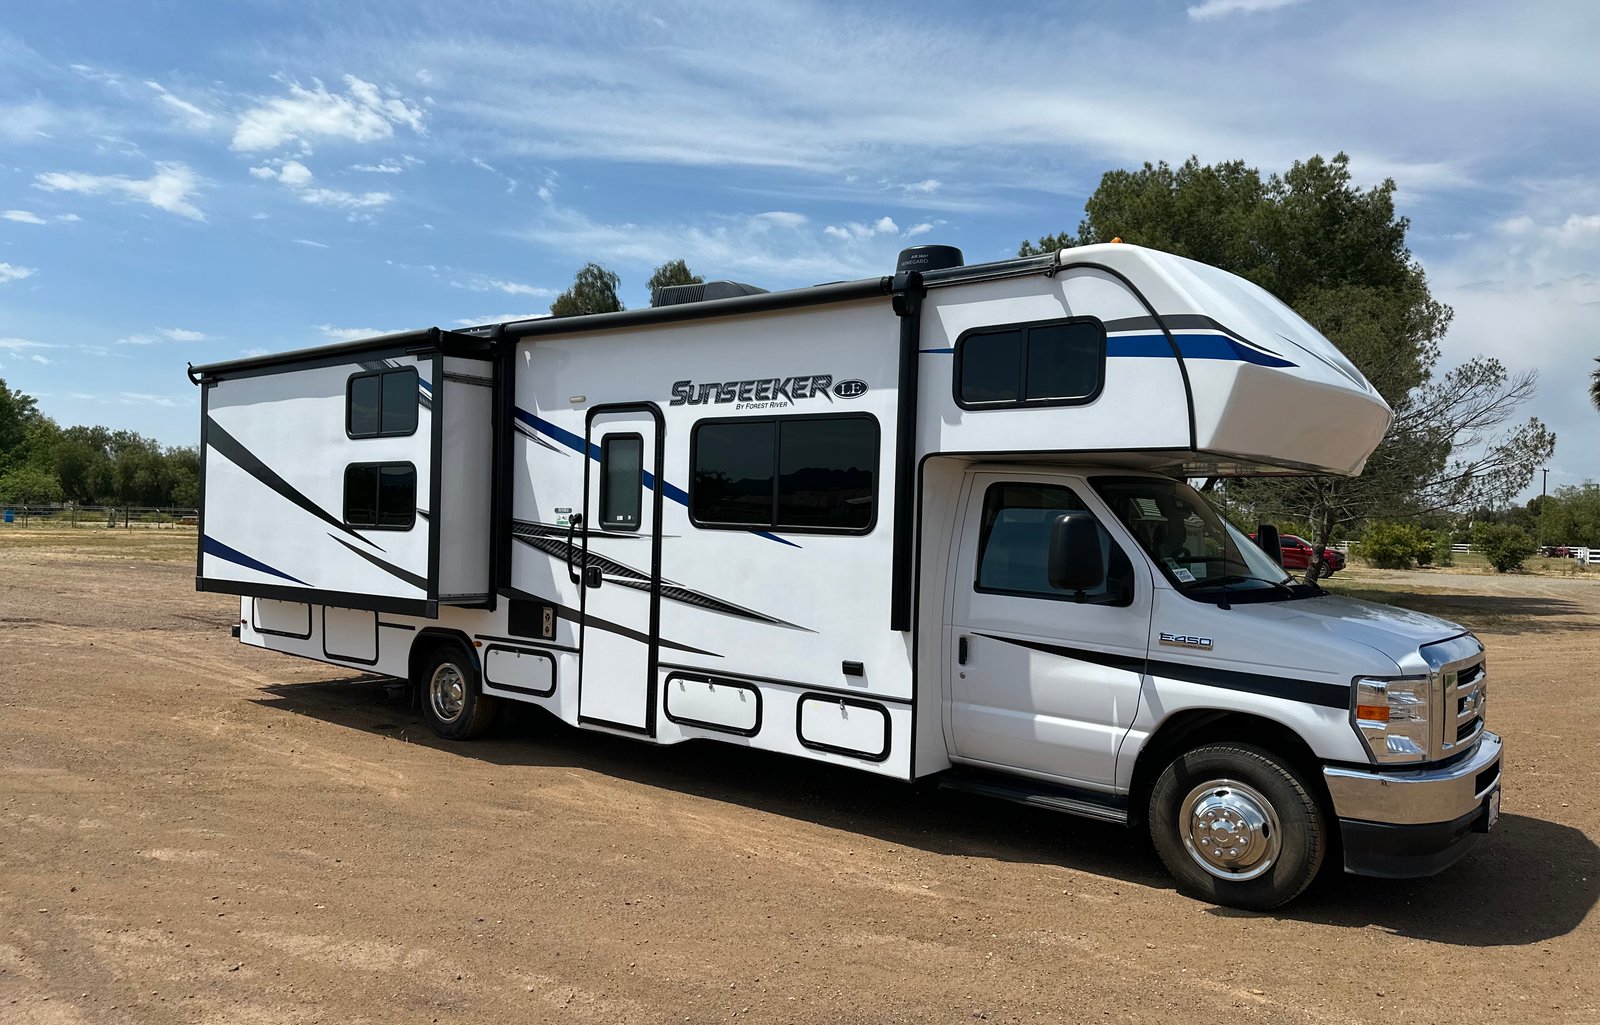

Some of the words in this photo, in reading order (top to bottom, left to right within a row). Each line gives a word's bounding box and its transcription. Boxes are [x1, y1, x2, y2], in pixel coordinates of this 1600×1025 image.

[669, 374, 834, 406] SUNSEEKER
[840, 381, 863, 395] LE
[745, 402, 768, 410] FOREST
